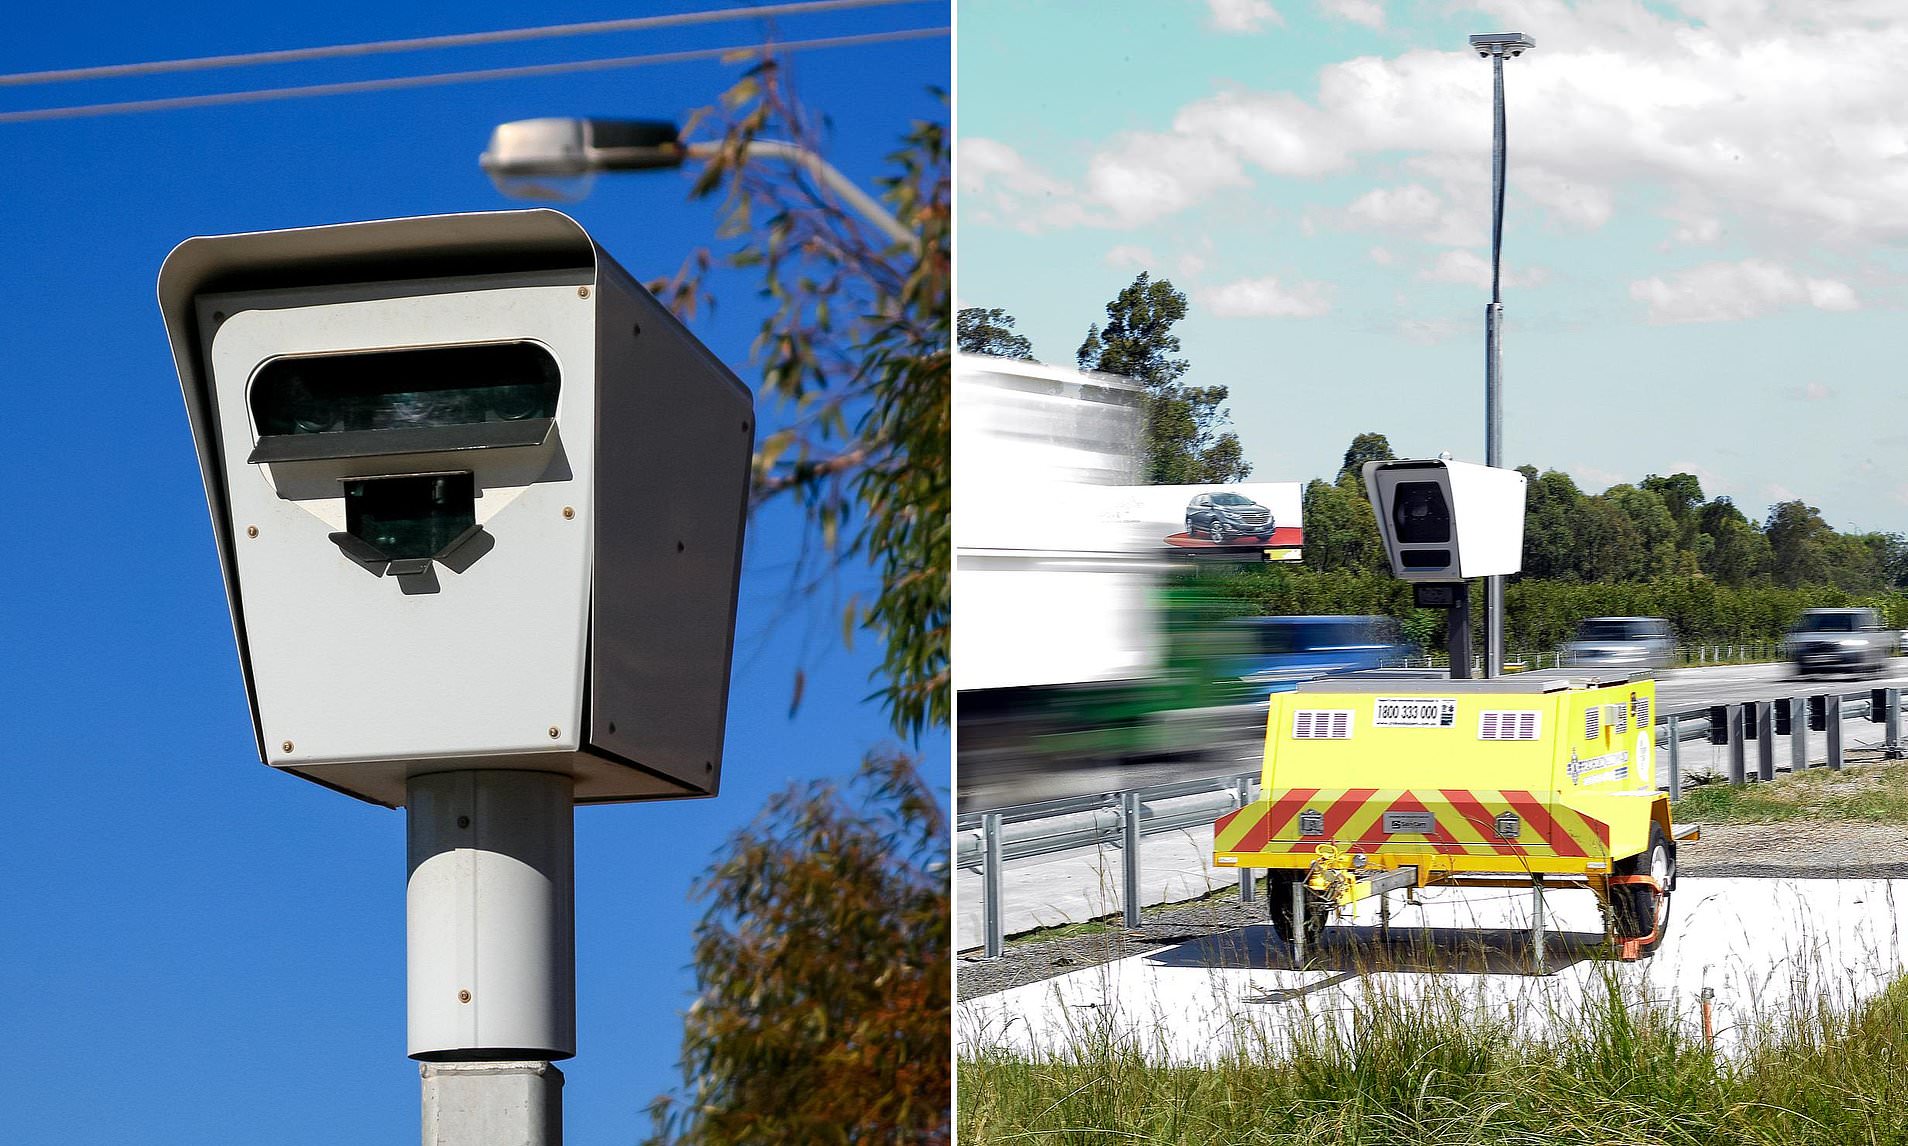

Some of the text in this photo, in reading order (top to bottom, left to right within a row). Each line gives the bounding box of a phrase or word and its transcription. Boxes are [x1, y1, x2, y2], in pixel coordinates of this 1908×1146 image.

[1378, 705, 1399, 719] 1800
[1401, 705, 1418, 719] 333
[1420, 705, 1438, 719] 000
